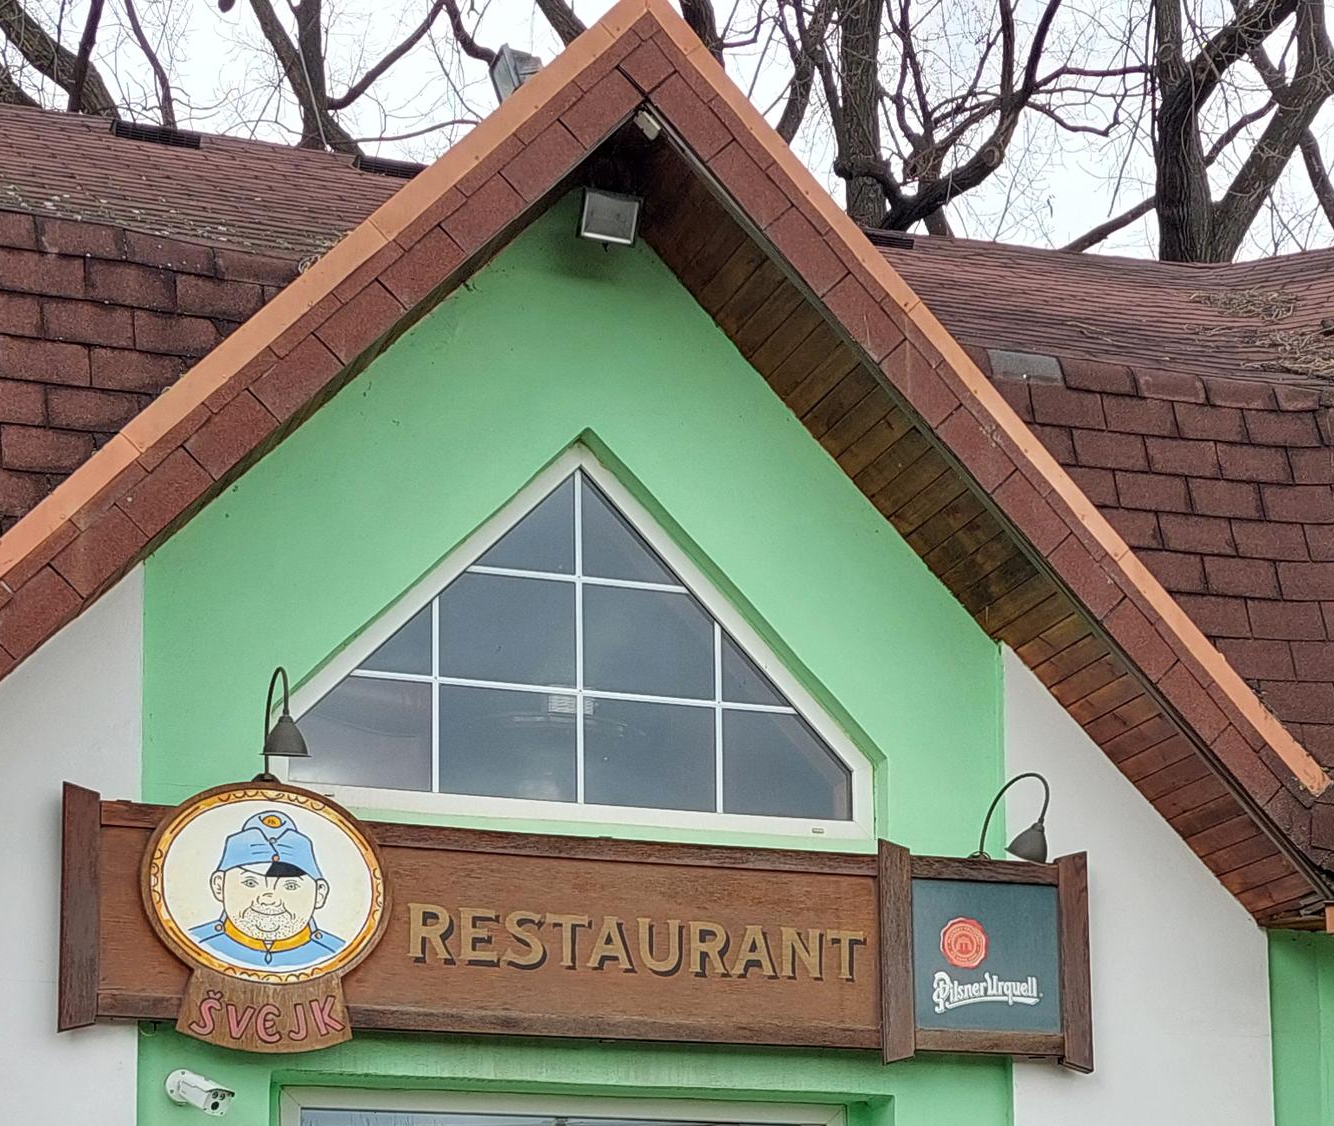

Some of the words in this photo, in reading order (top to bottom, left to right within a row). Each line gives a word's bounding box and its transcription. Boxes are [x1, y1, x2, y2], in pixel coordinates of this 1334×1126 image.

[406, 902, 867, 983] RESTAURANT
[188, 988, 346, 1045] ŠVEJK
[932, 971, 988, 1014] Pilsner
[984, 972, 1040, 1006] Urquell
